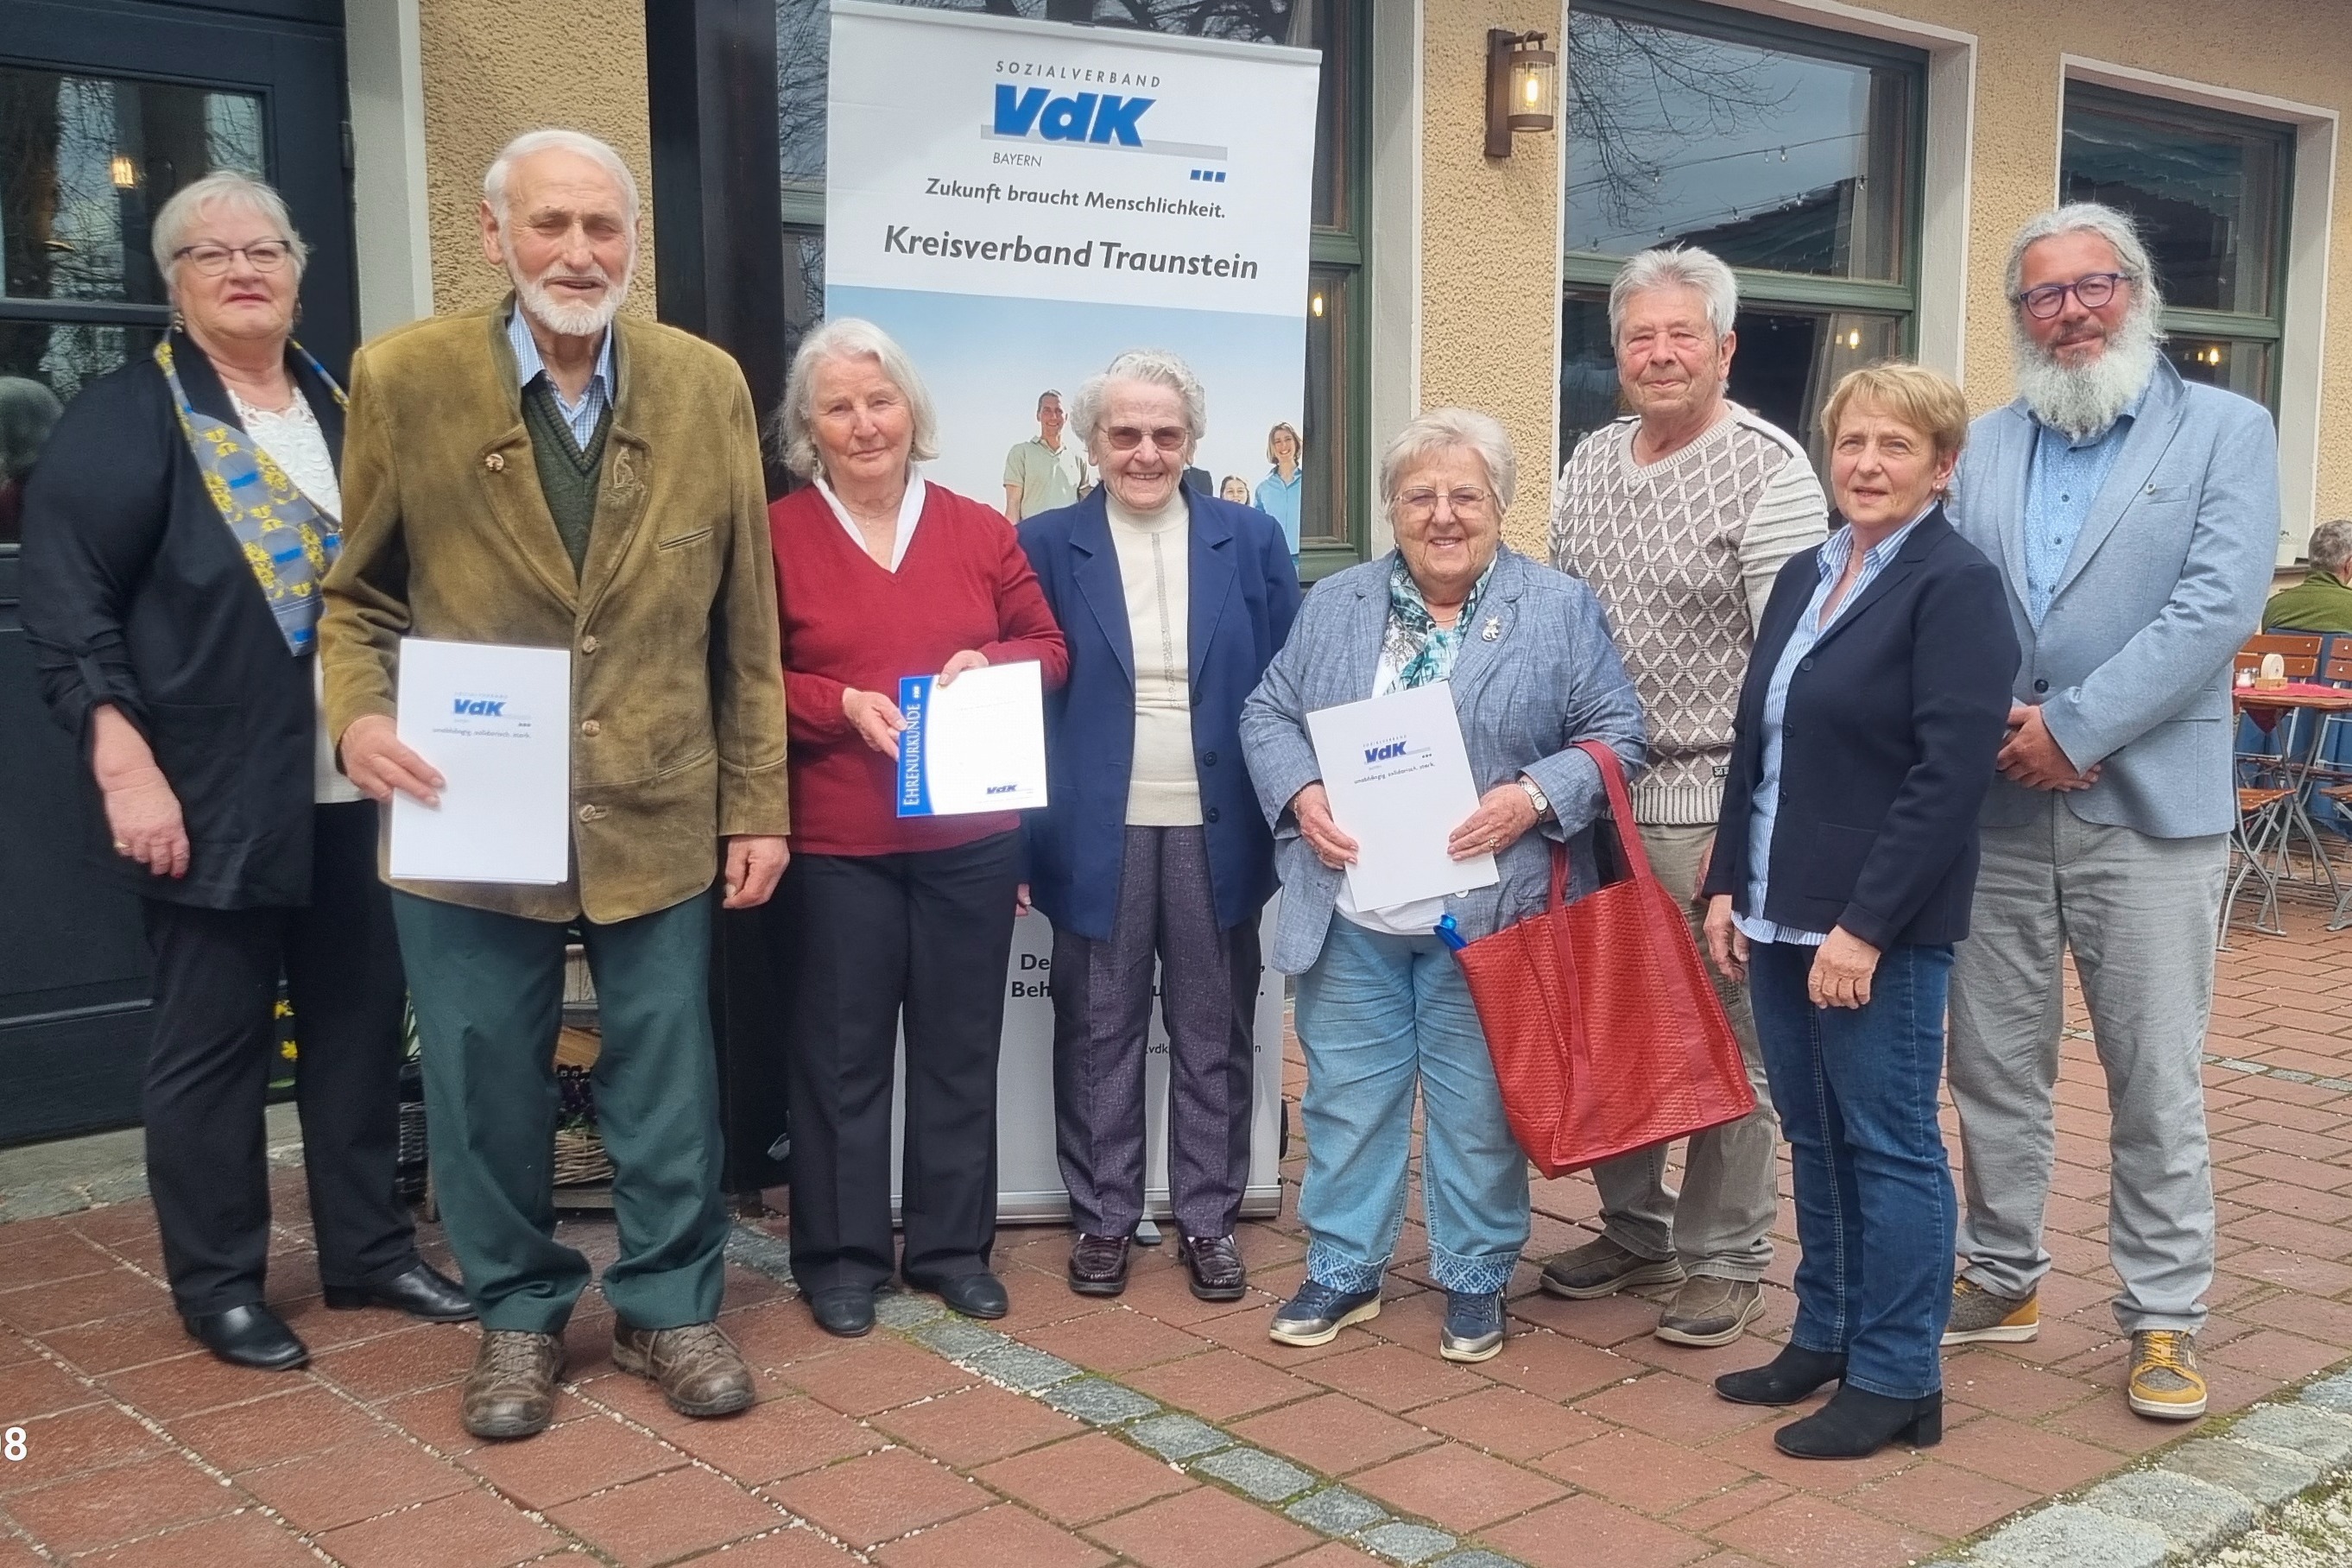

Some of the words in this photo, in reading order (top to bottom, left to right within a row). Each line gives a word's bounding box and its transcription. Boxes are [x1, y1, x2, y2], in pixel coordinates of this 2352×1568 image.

[996, 60, 1161, 89] SOZIALVERBAND
[994, 84, 1156, 147] VdK
[992, 151, 1042, 168] BAYERN
[925, 177, 1002, 201] Zukunft
[1007, 185, 1079, 207] braucht
[1084, 191, 1226, 219] Menschlichkeit.
[883, 224, 1092, 269] Kreisverband
[1099, 241, 1259, 280] Traunstein
[454, 699, 507, 717] VdK
[902, 703, 921, 806] EHRENURKUNDE
[1363, 740, 1407, 763] VdK
[986, 784, 1017, 794] VdK
[1021, 953, 1051, 971] De
[1011, 981, 1052, 998] Beh
